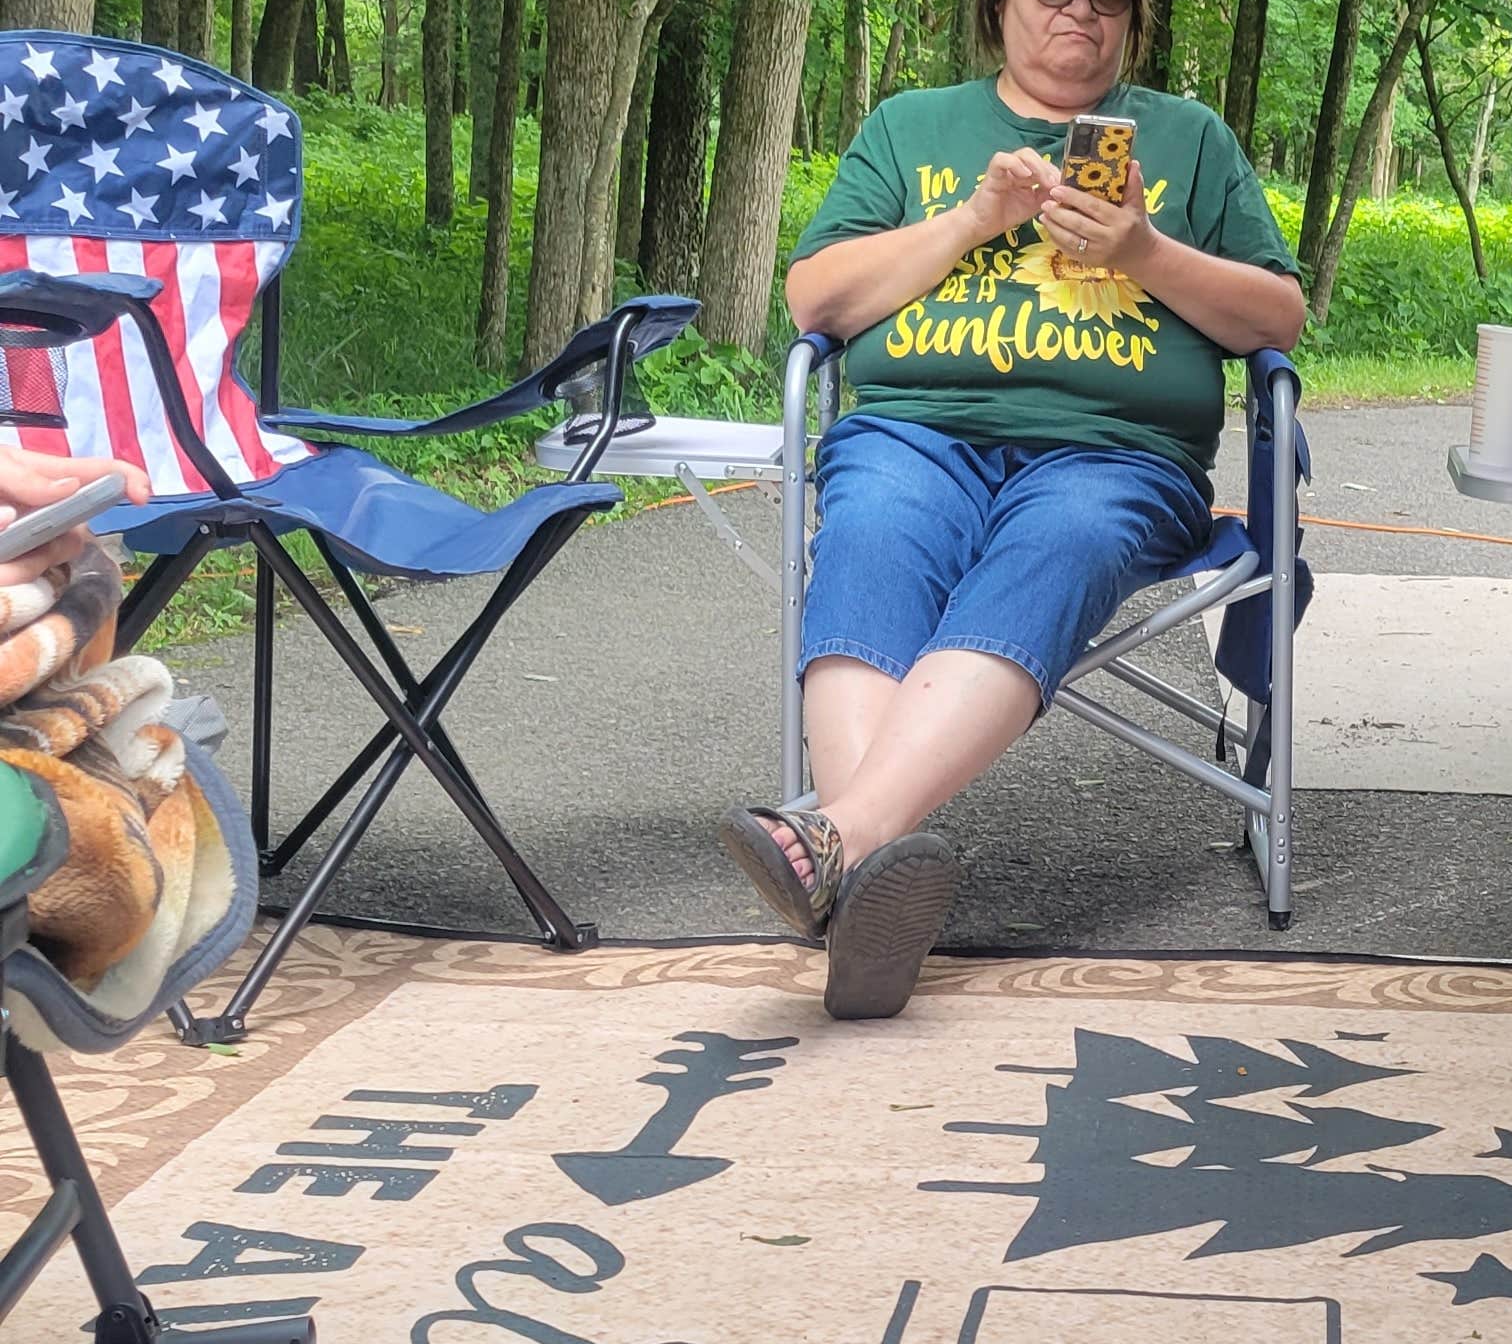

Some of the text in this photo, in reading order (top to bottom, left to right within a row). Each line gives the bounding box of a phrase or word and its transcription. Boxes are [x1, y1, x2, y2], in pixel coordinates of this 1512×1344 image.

[916, 164, 961, 205] In
[935, 273, 997, 304] BE A
[885, 299, 1157, 373] Sunflower
[232, 1082, 540, 1203] THE
